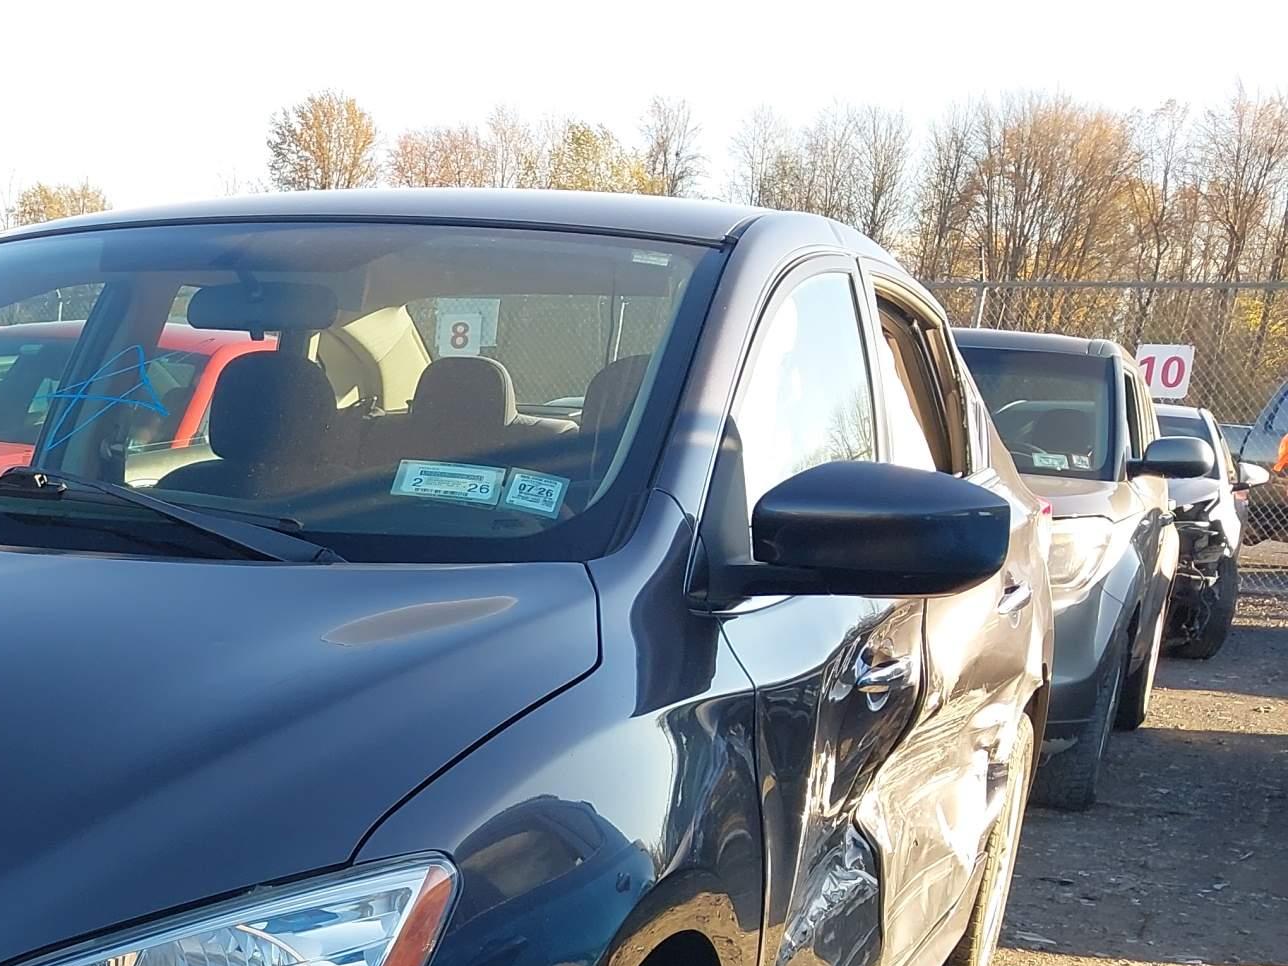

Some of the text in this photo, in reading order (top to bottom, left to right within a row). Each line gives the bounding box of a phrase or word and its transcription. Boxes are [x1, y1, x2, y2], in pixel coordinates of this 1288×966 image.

[451, 321, 470, 350] 8
[1138, 355, 1186, 388] 10
[412, 477, 424, 487] 2
[467, 483, 490, 494] 26
